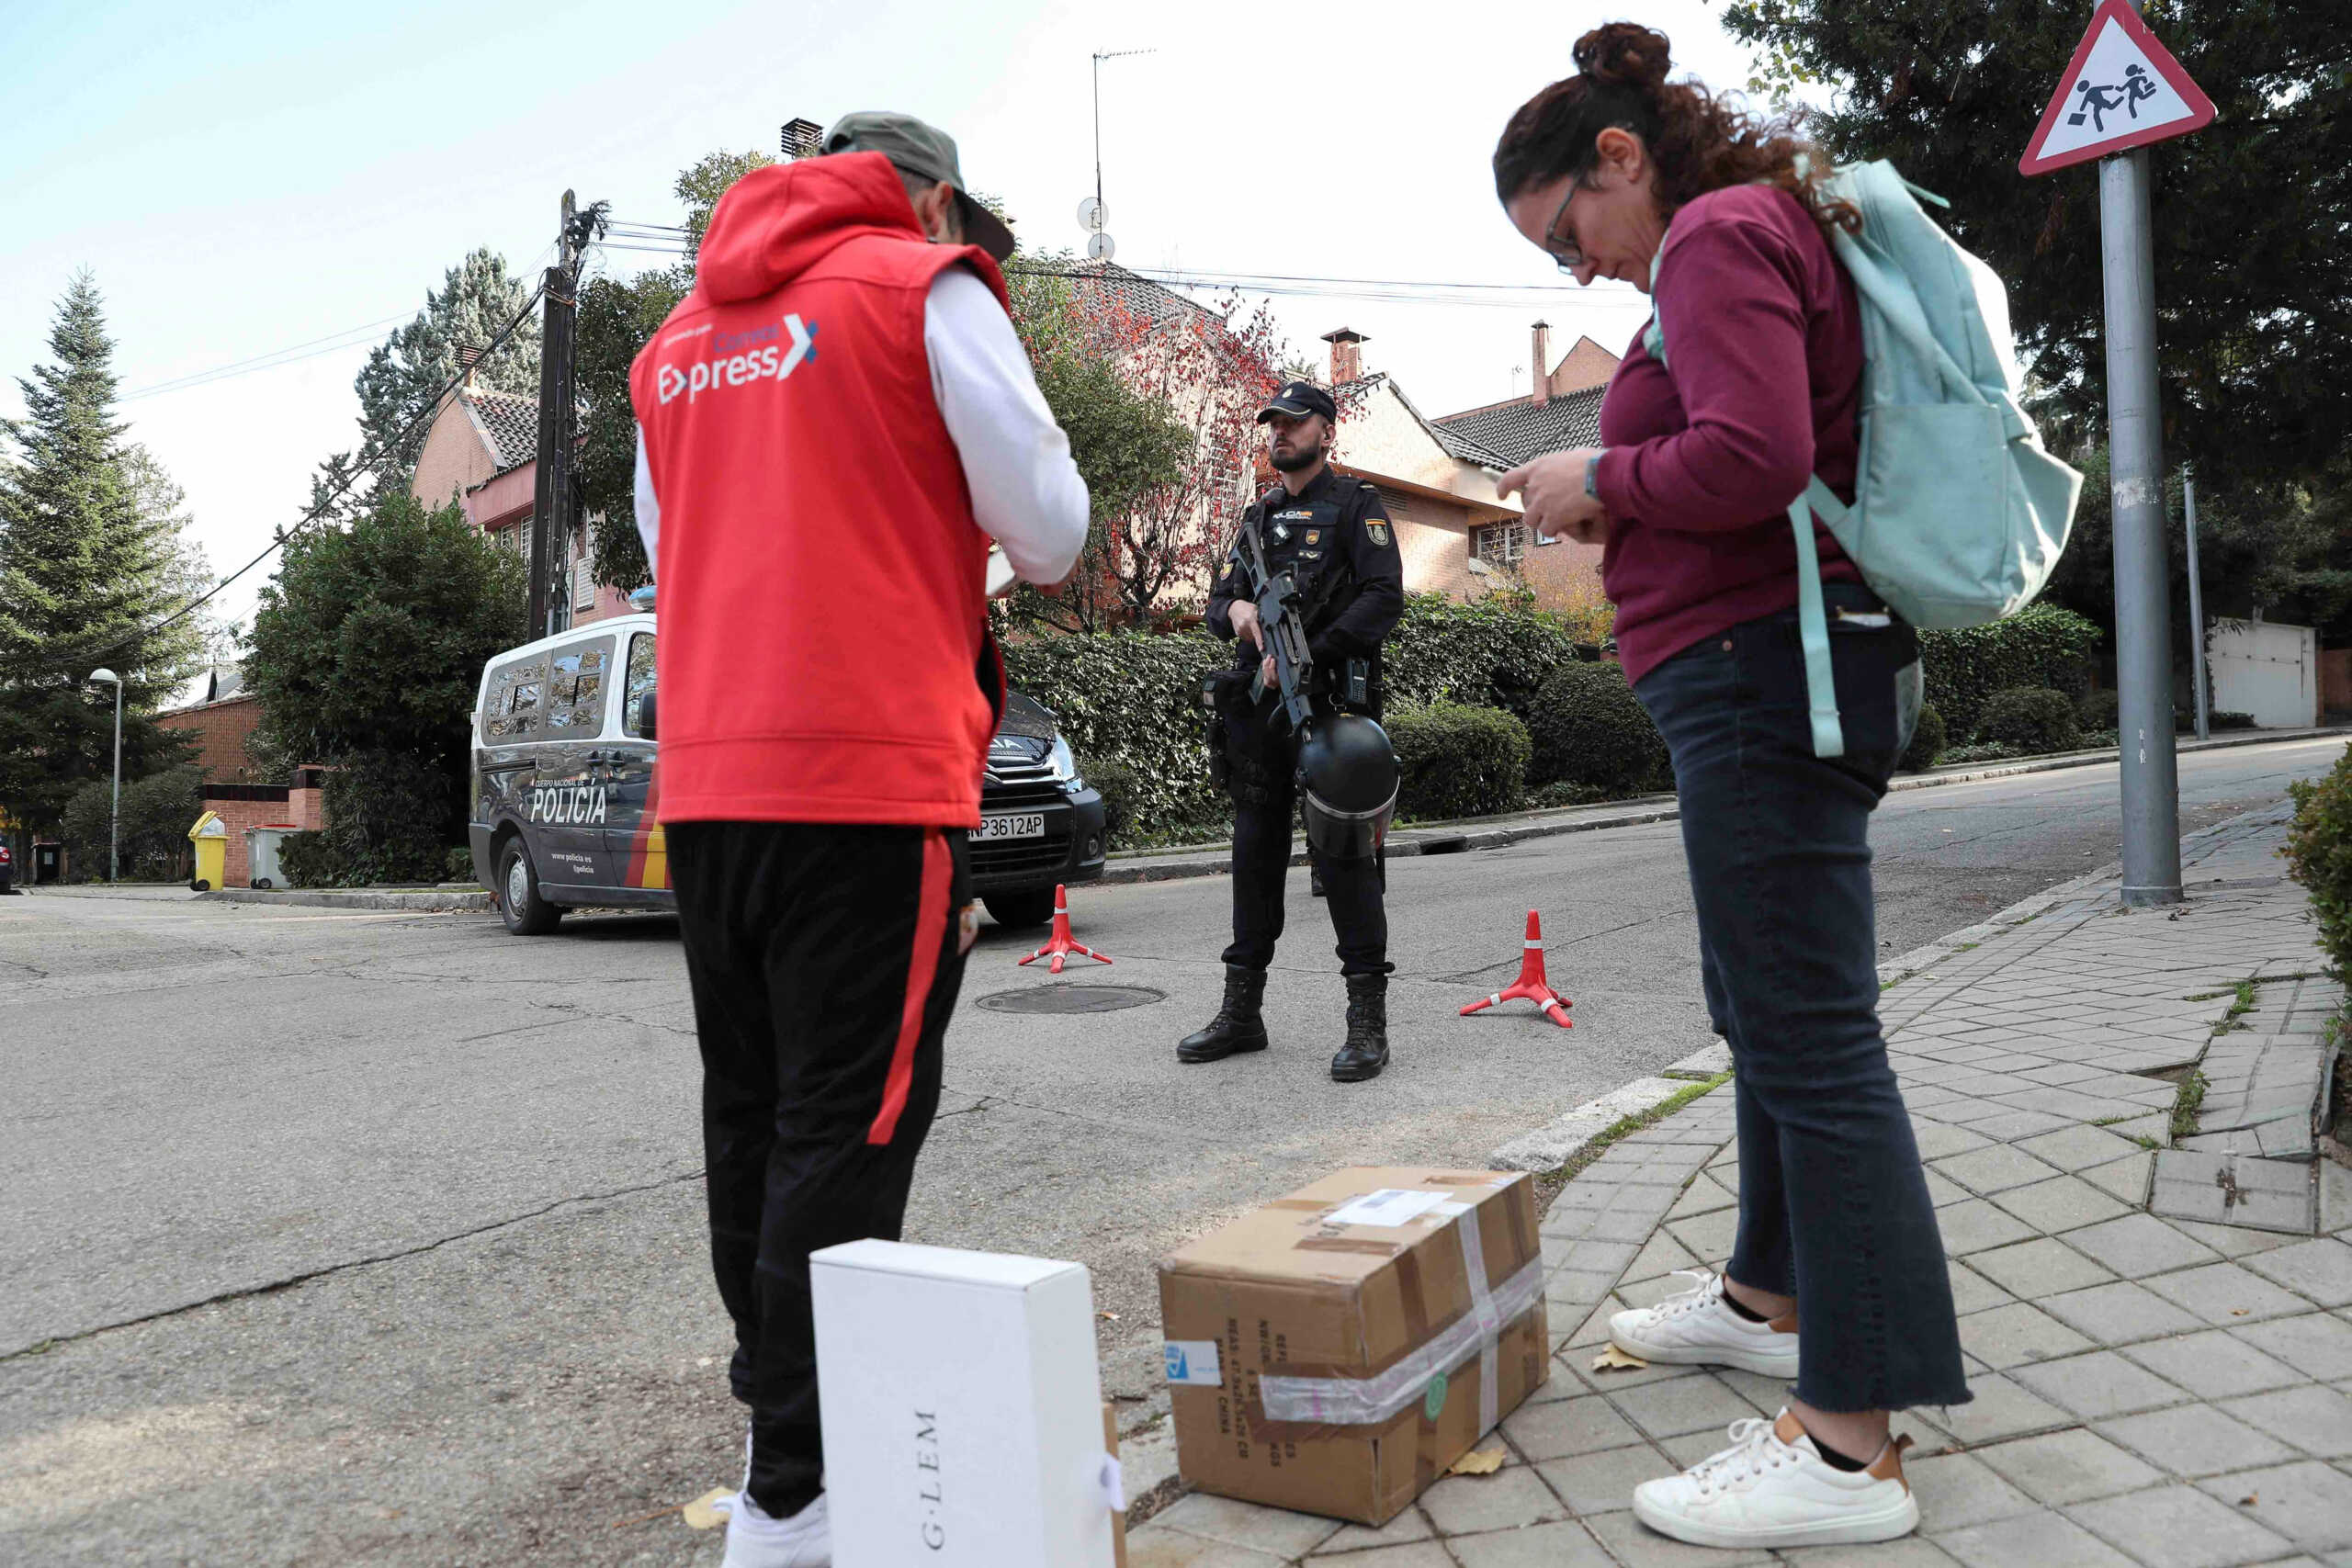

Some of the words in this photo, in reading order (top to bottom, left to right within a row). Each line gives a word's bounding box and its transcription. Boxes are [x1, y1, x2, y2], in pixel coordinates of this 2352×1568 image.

[658, 345, 779, 405] Express
[530, 778, 605, 823] POLICÍA
[967, 817, 1042, 838] NP3612AP
[1218, 1396, 1229, 1434] CHINA
